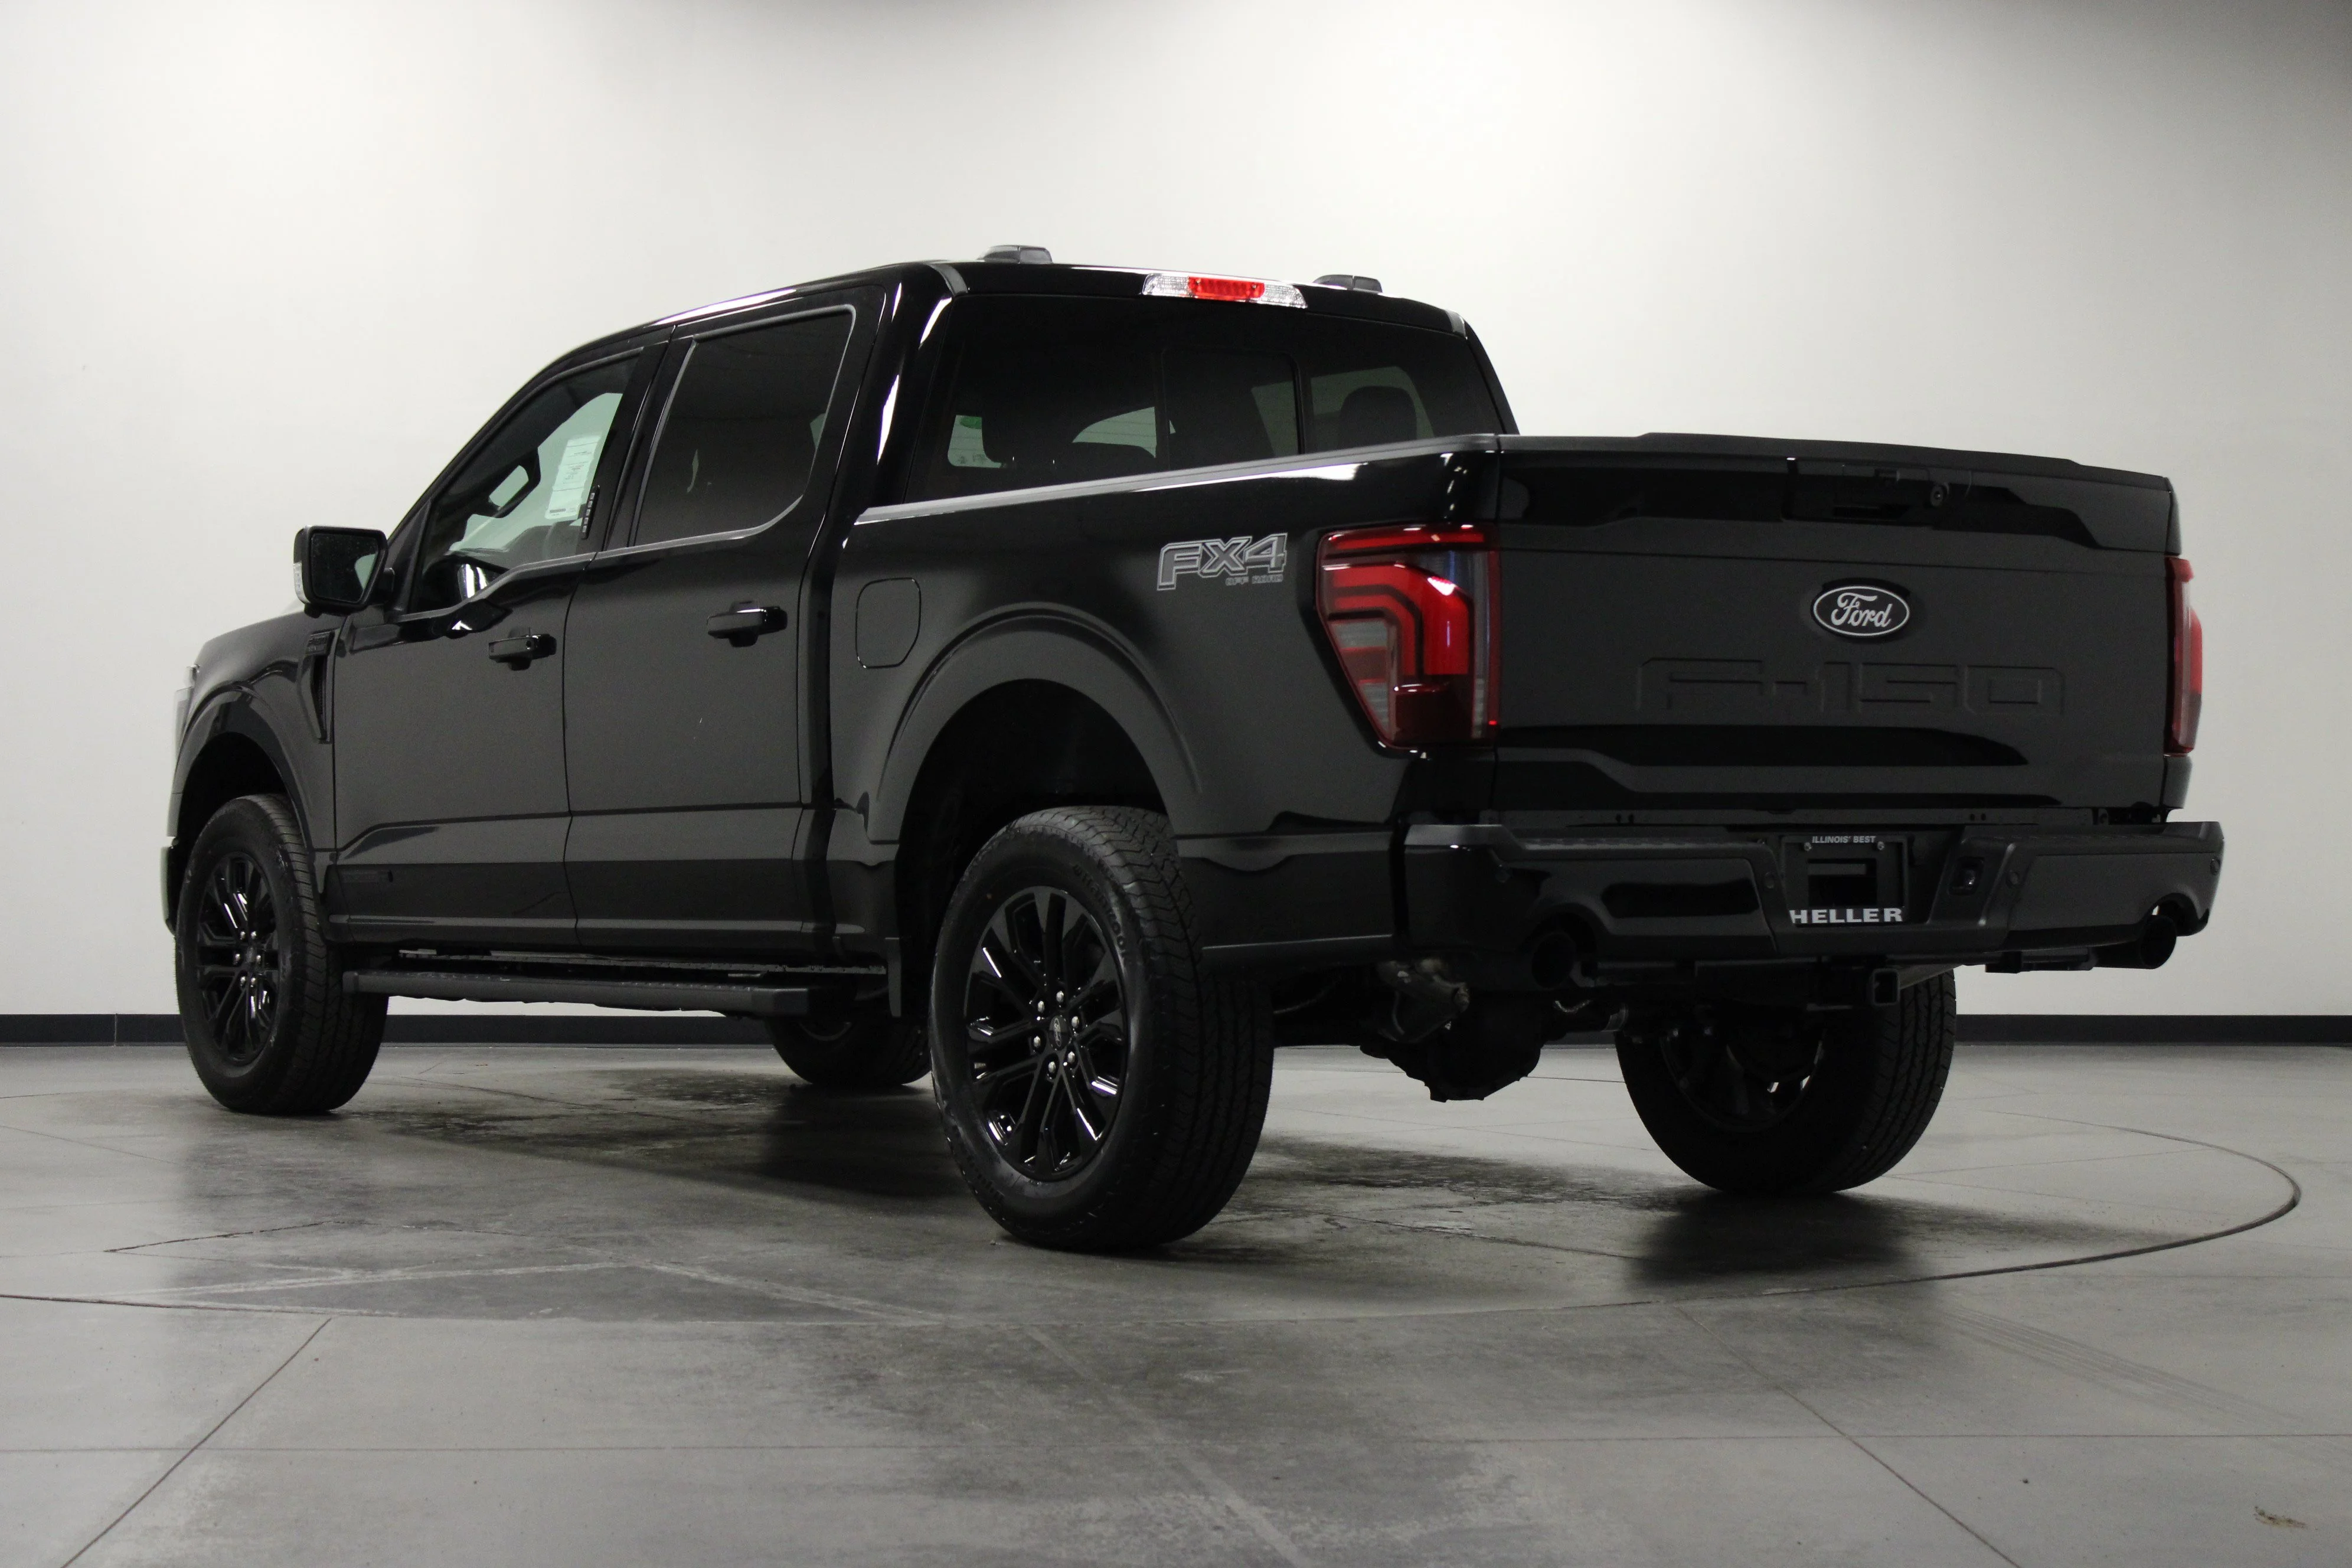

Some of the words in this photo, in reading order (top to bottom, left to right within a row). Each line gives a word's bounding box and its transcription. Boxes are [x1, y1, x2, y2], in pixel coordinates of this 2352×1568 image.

[1157, 532, 1288, 590] FX4
[1831, 592, 1892, 628] Ford
[1635, 657, 2064, 714] F-150
[1853, 835, 1876, 844] BEST
[1789, 907, 1903, 924] HELLER
